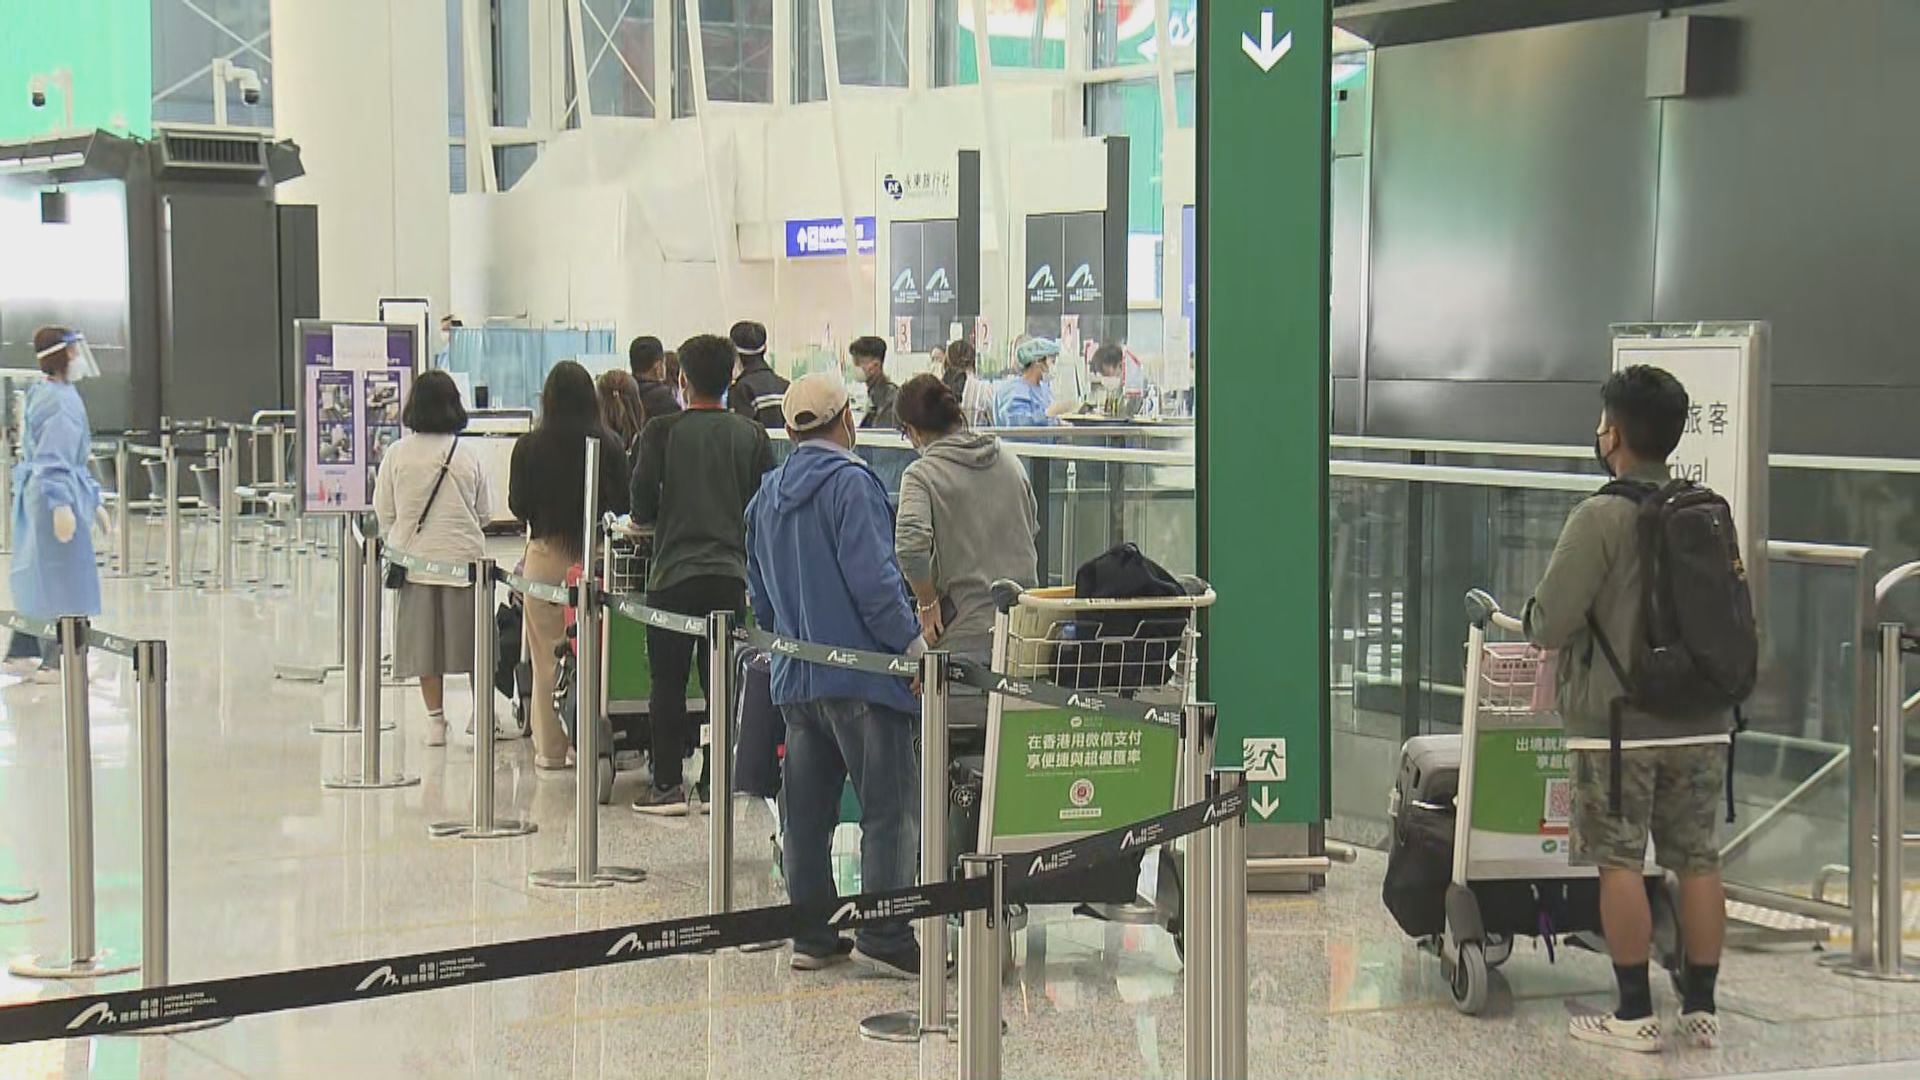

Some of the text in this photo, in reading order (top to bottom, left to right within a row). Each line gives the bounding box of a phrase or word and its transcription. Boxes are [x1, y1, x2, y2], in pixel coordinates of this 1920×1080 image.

[1028, 730, 1142, 750] 在香港用微信支付
